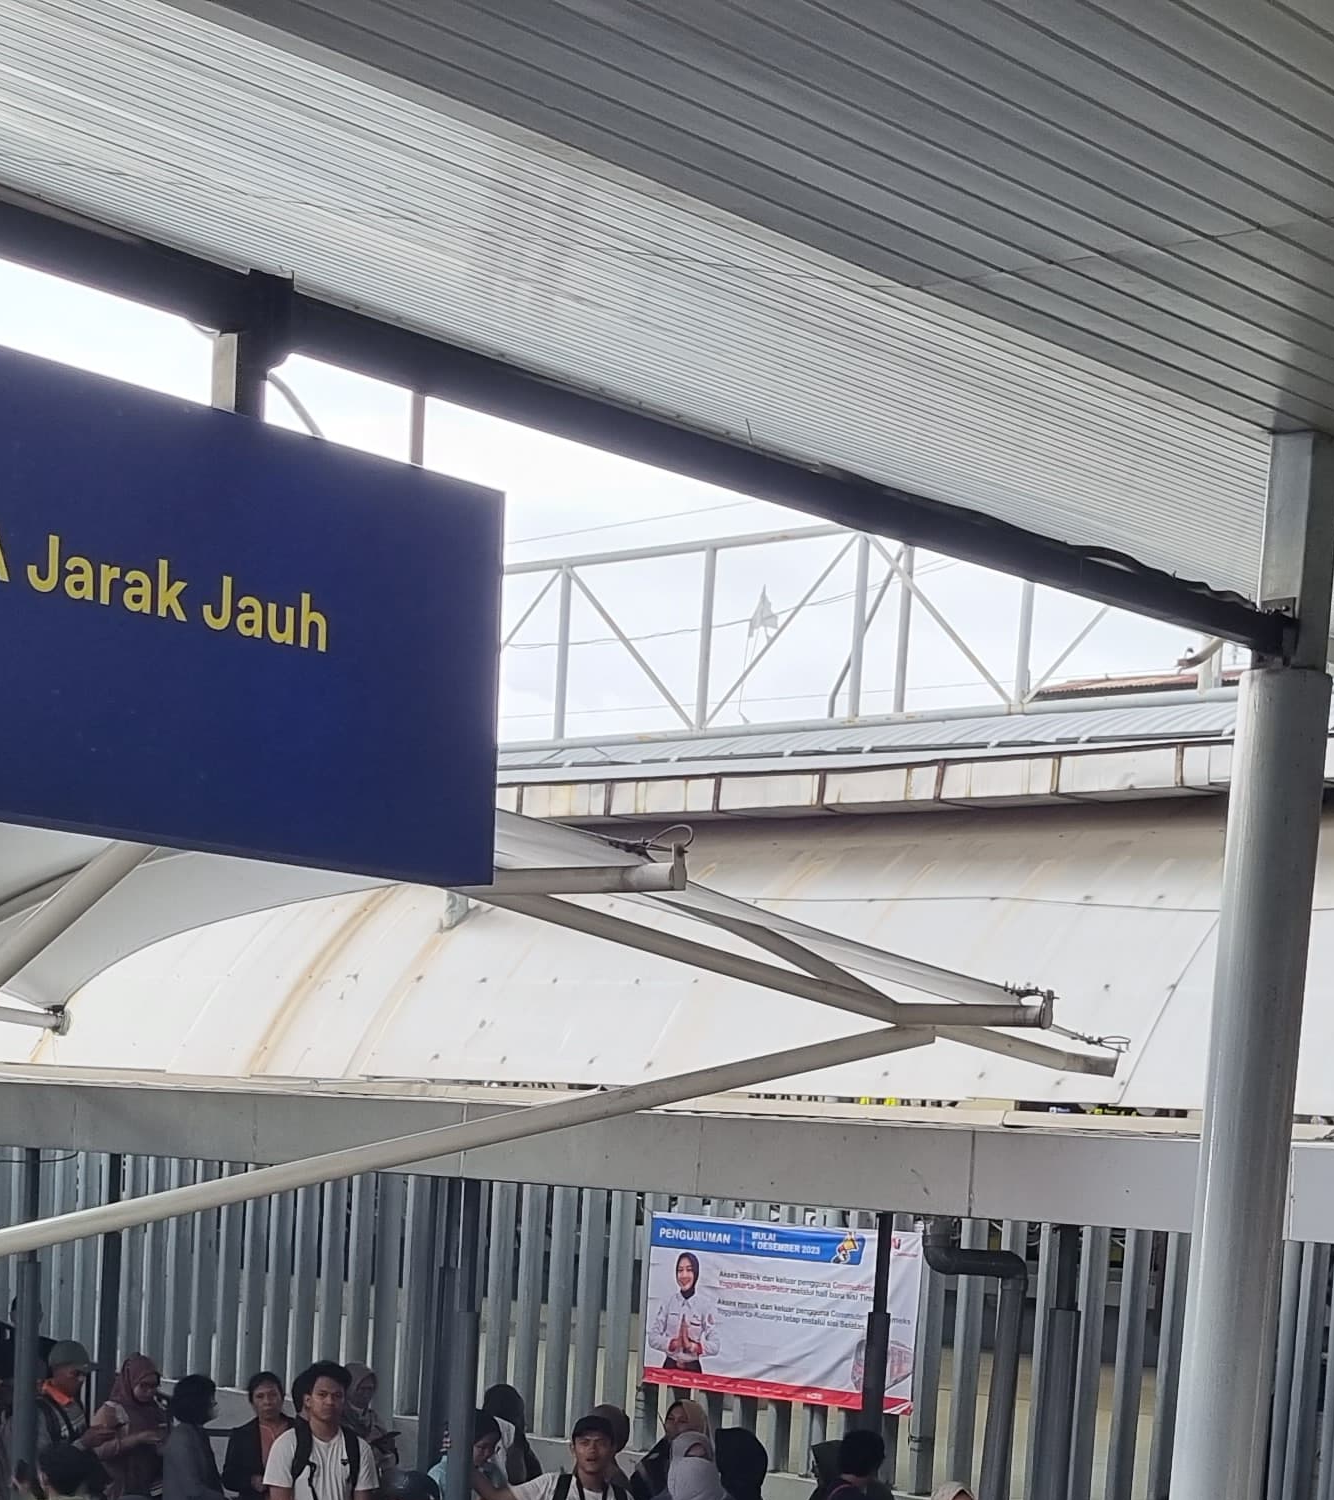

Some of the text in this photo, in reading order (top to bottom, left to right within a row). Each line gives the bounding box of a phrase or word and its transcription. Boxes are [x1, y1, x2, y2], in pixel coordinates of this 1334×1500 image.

[26, 534, 188, 622] Jarak
[202, 575, 328, 653] Jauh
[659, 1227, 731, 1244] PENGUMUMAN
[751, 1231, 777, 1242] MULAI
[757, 1241, 801, 1253] DESEMBER
